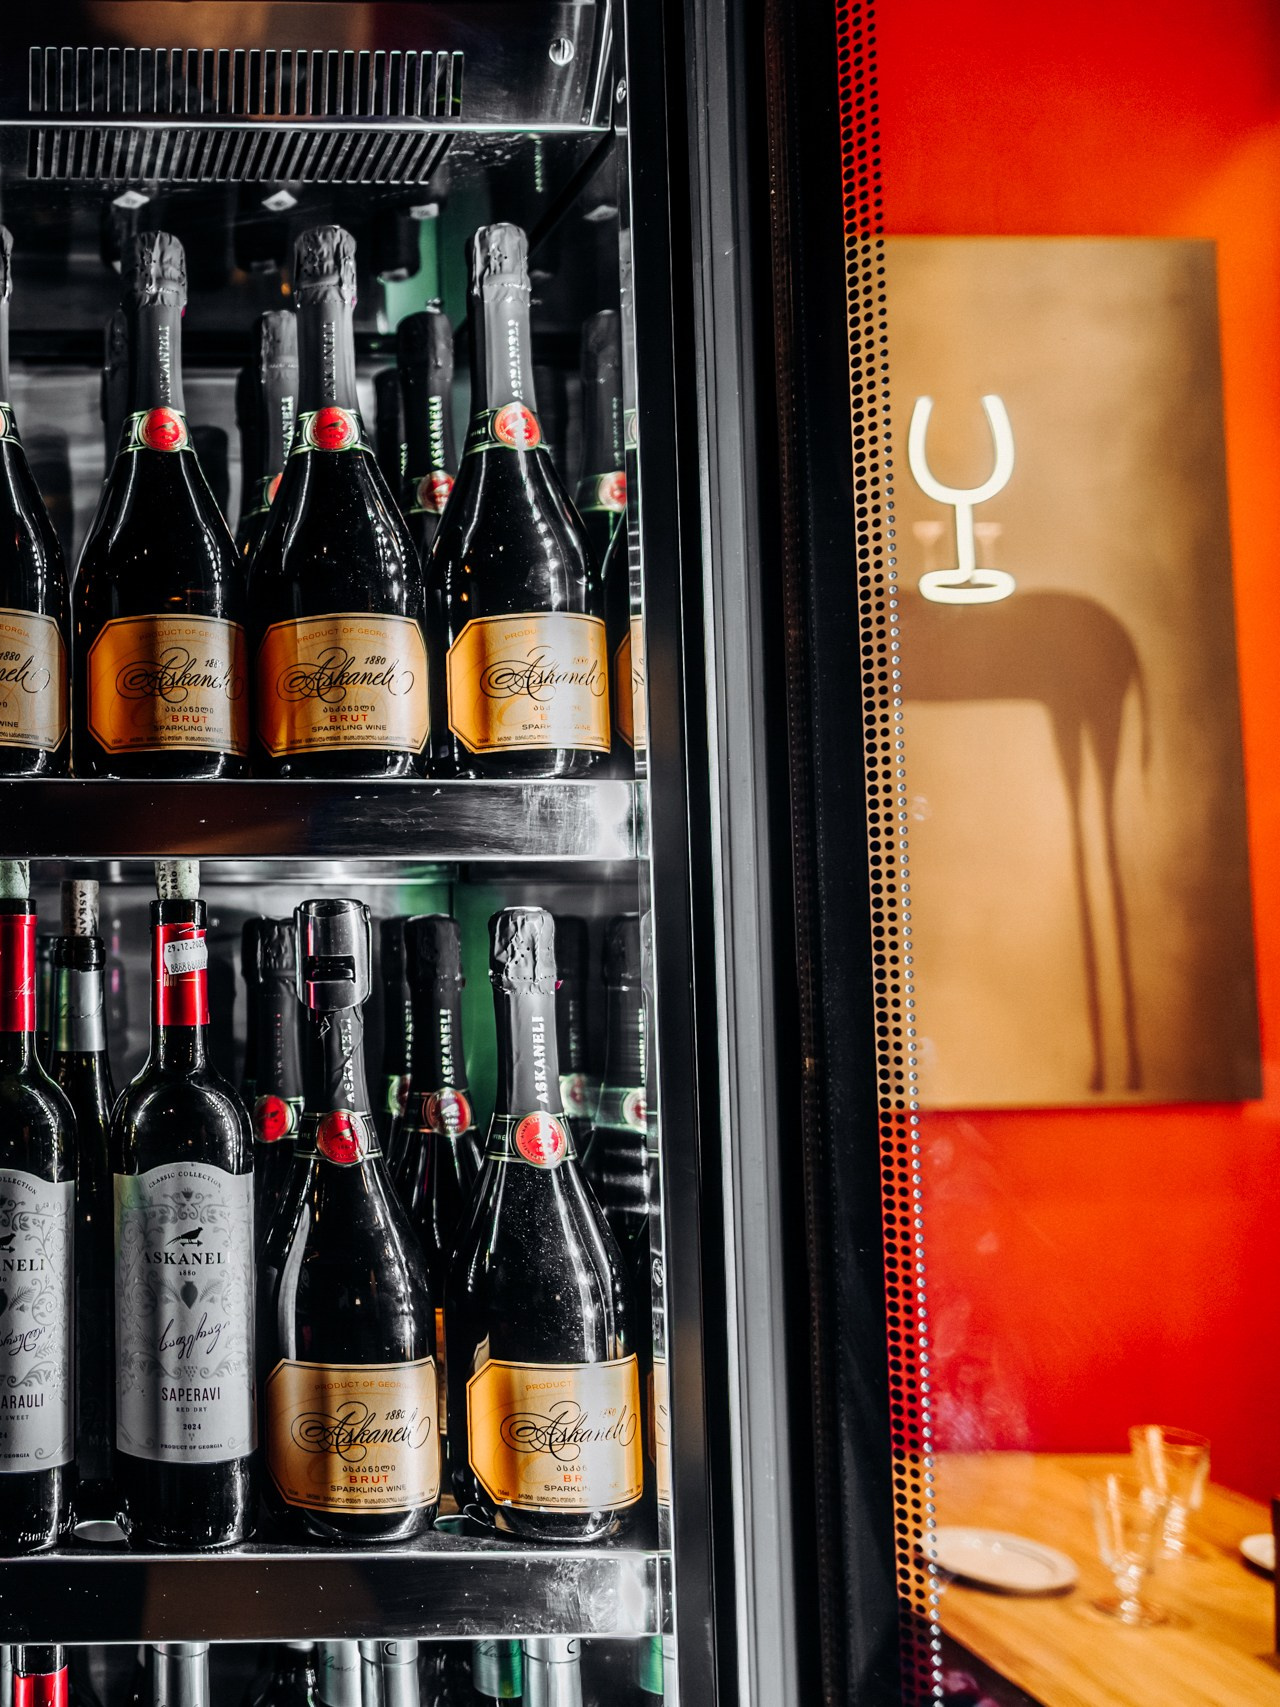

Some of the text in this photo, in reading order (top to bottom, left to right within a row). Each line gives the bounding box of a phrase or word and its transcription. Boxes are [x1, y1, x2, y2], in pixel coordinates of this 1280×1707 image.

[297, 629, 340, 645] PRODUCT
[504, 629, 540, 641] PRODU
[364, 656, 387, 665] 1880
[171, 715, 208, 723] BRUT
[329, 714, 369, 723] BRUT
[204, 726, 224, 734] WINE
[311, 724, 363, 732] SPARKLING
[440, 1008, 455, 1085] ASKANELI
[532, 1016, 549, 1104] ASKANELI
[148, 1171, 222, 1189] CLASSIC COLLECTION
[314, 1381, 360, 1391] PRODUCT
[525, 1380, 573, 1392] PRODUCT
[161, 1386, 221, 1402] SAPERAVI
[349, 1475, 389, 1484] BRUT
[330, 1485, 384, 1493] SPARKLING
